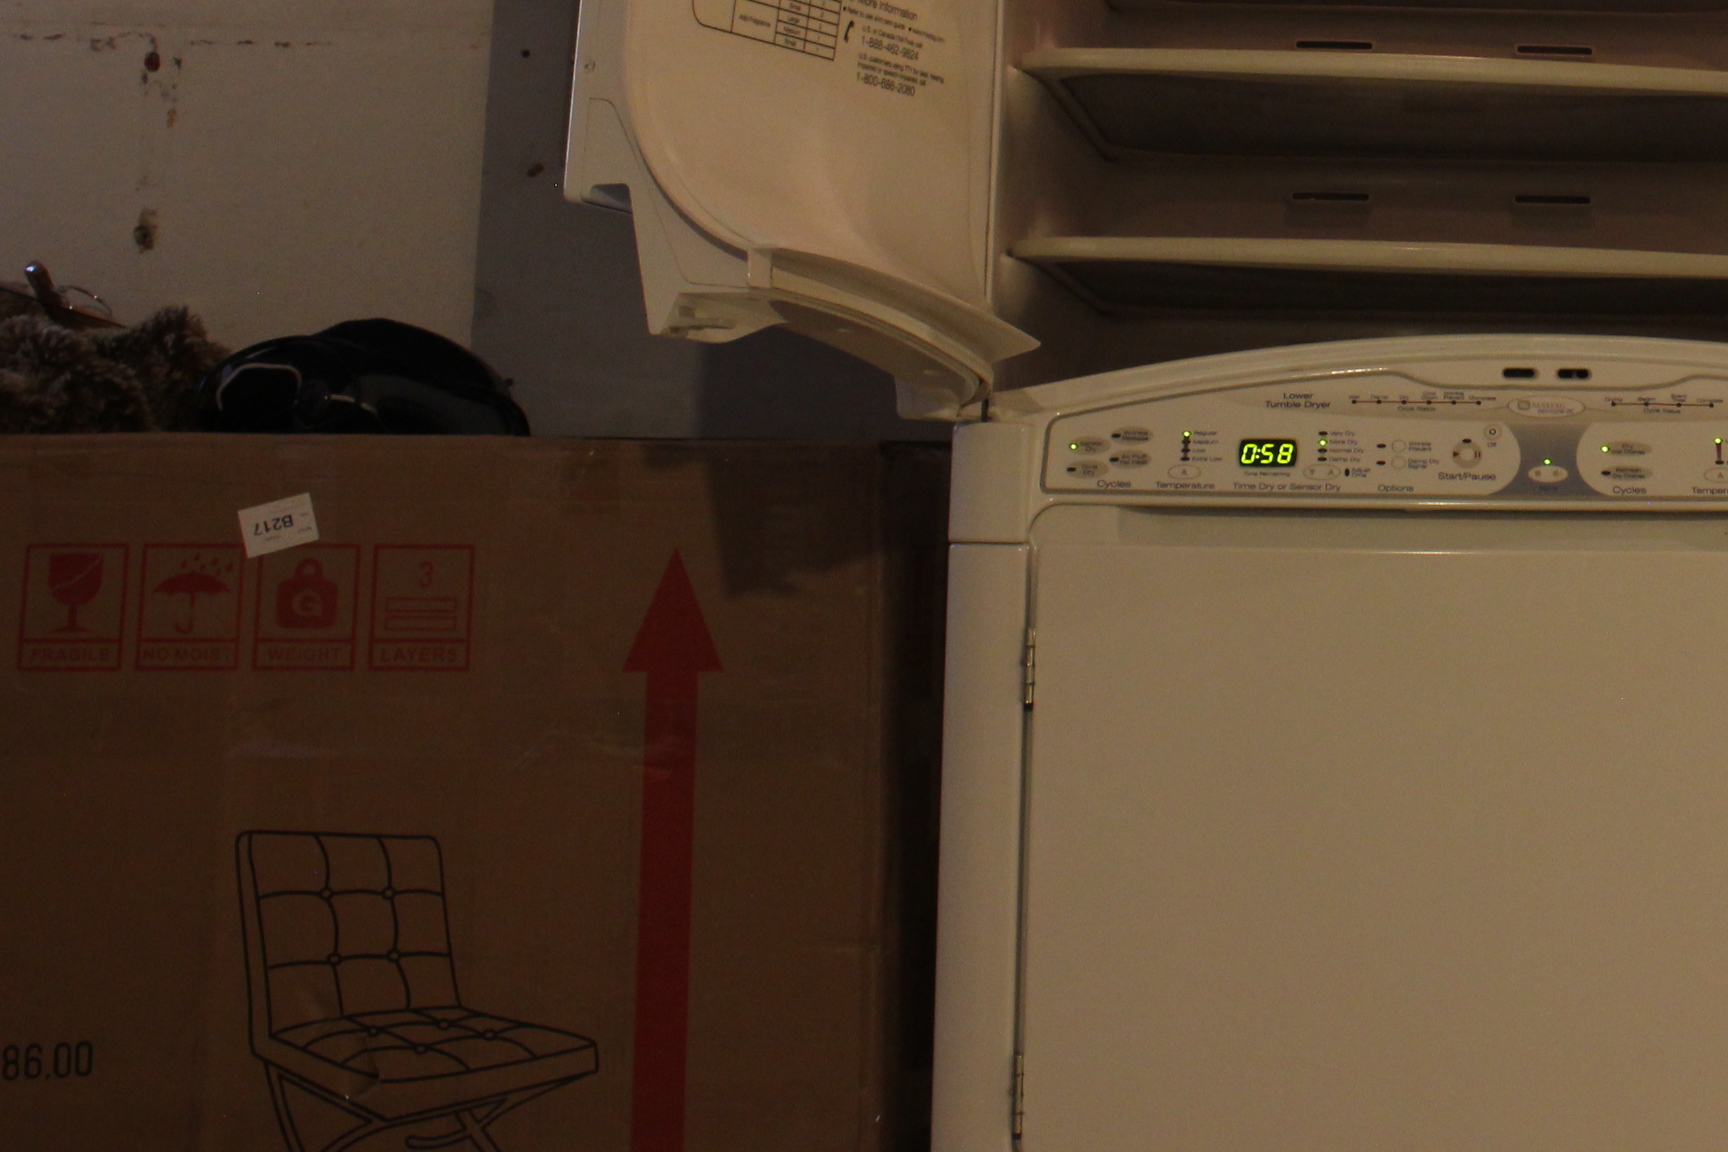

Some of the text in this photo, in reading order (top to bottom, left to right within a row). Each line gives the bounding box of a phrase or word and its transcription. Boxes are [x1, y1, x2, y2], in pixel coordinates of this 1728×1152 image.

[878, 0, 917, 21] Information
[1283, 392, 1314, 400] Lower
[1265, 400, 1331, 410] Tumble Dryer
[1241, 443, 1294, 464] 0:58
[1437, 472, 1497, 482] Start/Pause
[1097, 480, 1132, 489] Cycles
[1156, 481, 1216, 491] Temperature
[1257, 483, 1276, 492] Dry
[1290, 483, 1323, 491] Sensor
[1325, 483, 1342, 493] Dry
[1378, 483, 1414, 493] Options
[1613, 486, 1647, 496] Cycles
[253, 514, 294, 536] B217
[30, 646, 110, 664] FRAGILE
[267, 647, 340, 664] WEIGHT
[380, 647, 459, 664] LAYERS
